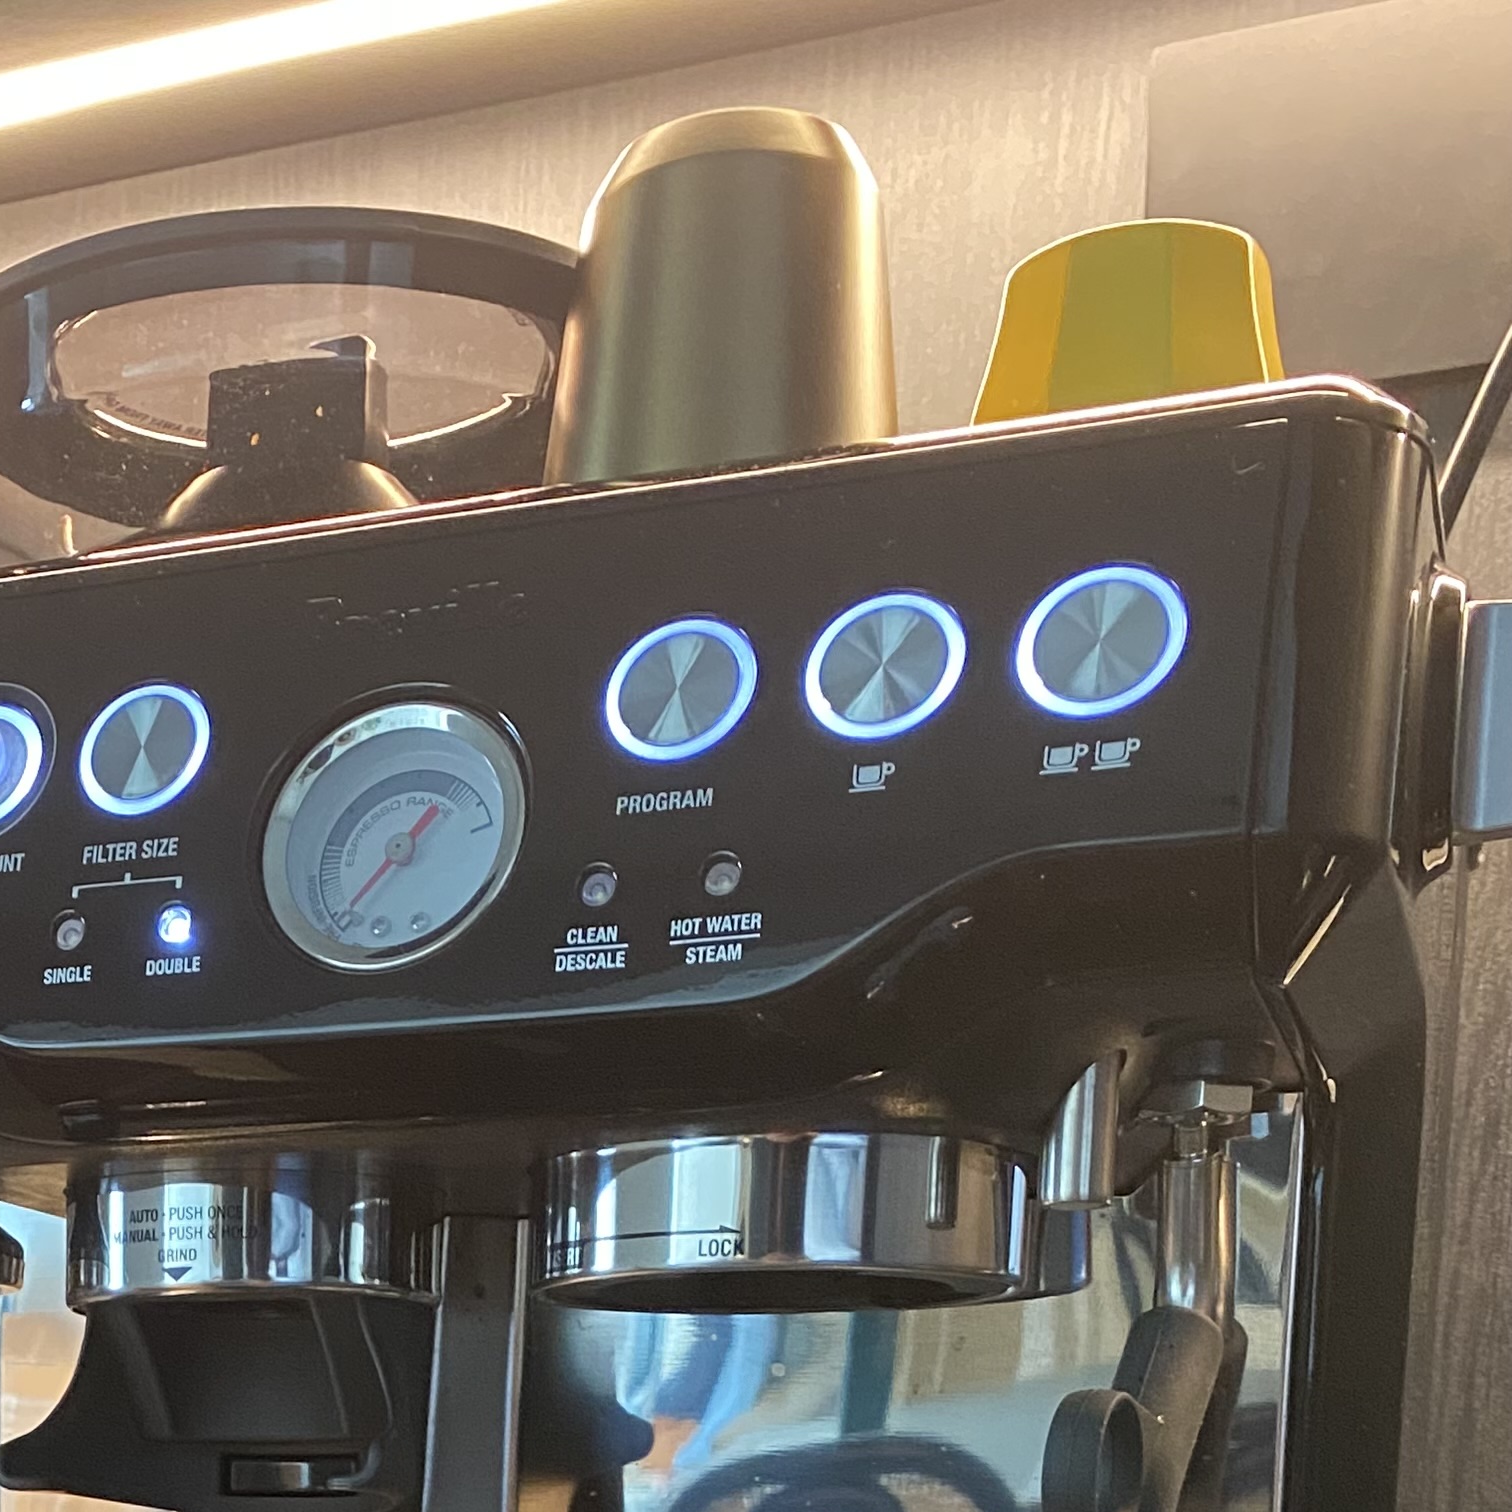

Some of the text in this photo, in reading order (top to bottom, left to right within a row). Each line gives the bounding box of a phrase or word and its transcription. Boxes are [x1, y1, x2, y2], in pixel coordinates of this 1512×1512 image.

[615, 787, 715, 816] PROGRAM
[344, 799, 402, 868] ESPRESSO
[82, 836, 179, 866] FILTER SIZE
[566, 924, 619, 946] CLEAN
[670, 912, 763, 937] HOT WATER
[554, 950, 627, 973] DESCALE
[685, 944, 743, 966] STEAM
[43, 964, 93, 985] SINGLE
[145, 956, 202, 978] DOUBLE
[129, 1205, 244, 1224] AUTO PUSH ONCE
[114, 1227, 160, 1244] MANUAL
[168, 1226, 203, 1240] PUSH
[207, 1225, 218, 1239] &
[157, 1248, 198, 1263] GRIND
[697, 1238, 746, 1258] LOCK
